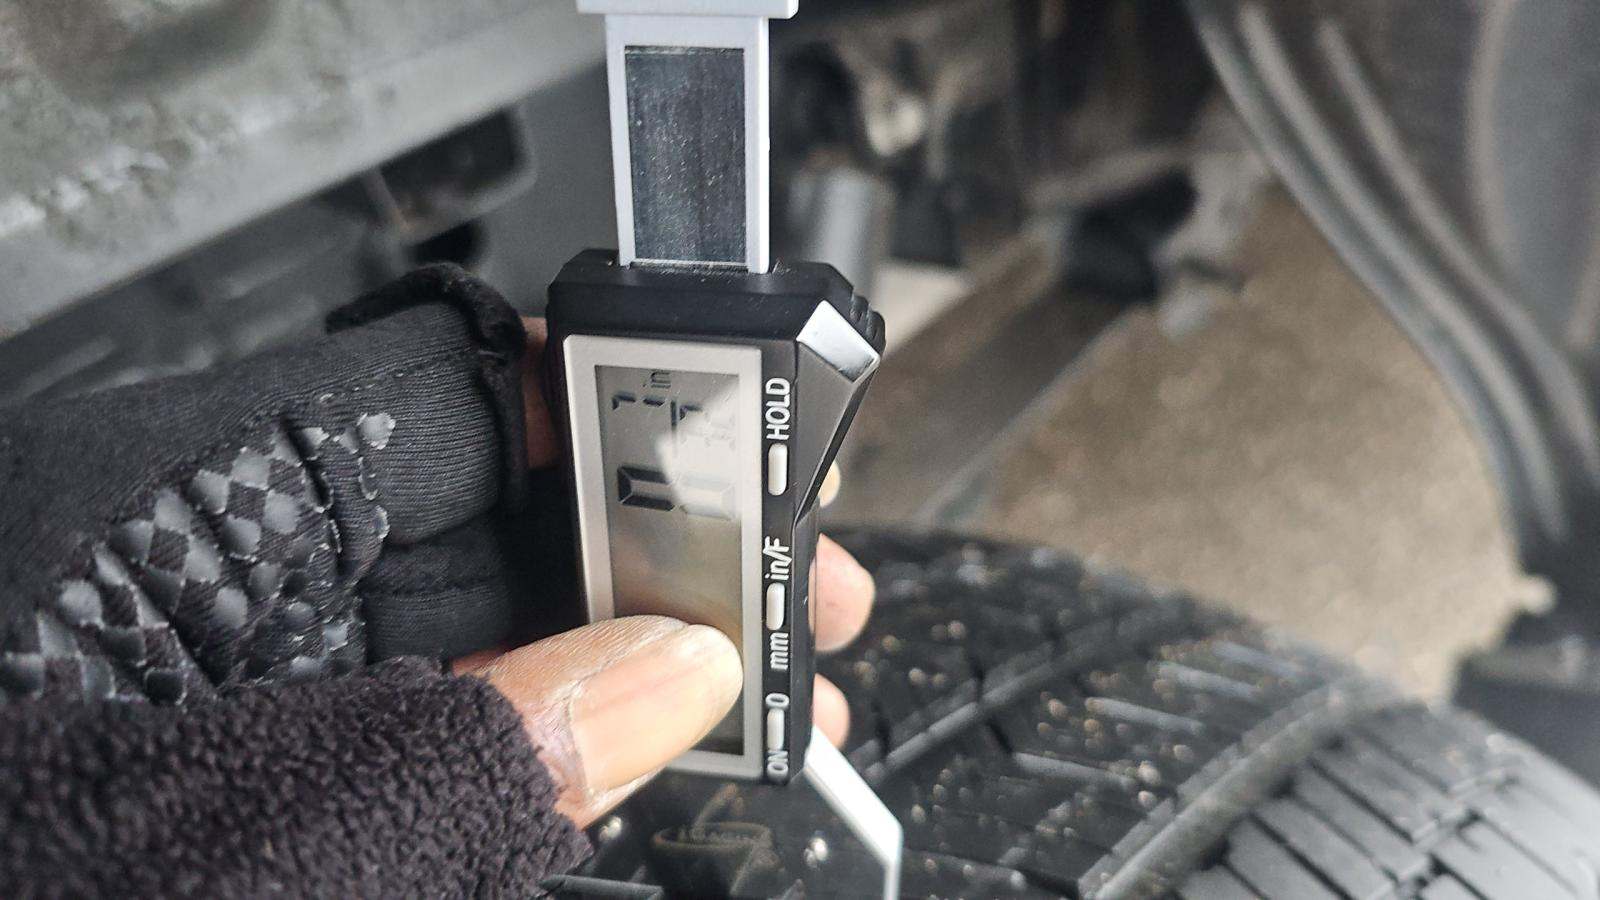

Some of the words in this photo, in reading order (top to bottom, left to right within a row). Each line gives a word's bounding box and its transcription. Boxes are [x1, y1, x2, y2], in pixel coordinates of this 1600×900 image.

[765, 377, 791, 440] HOLD
[762, 535, 792, 581] in/F
[769, 632, 789, 671] mm
[767, 750, 789, 779] ON
